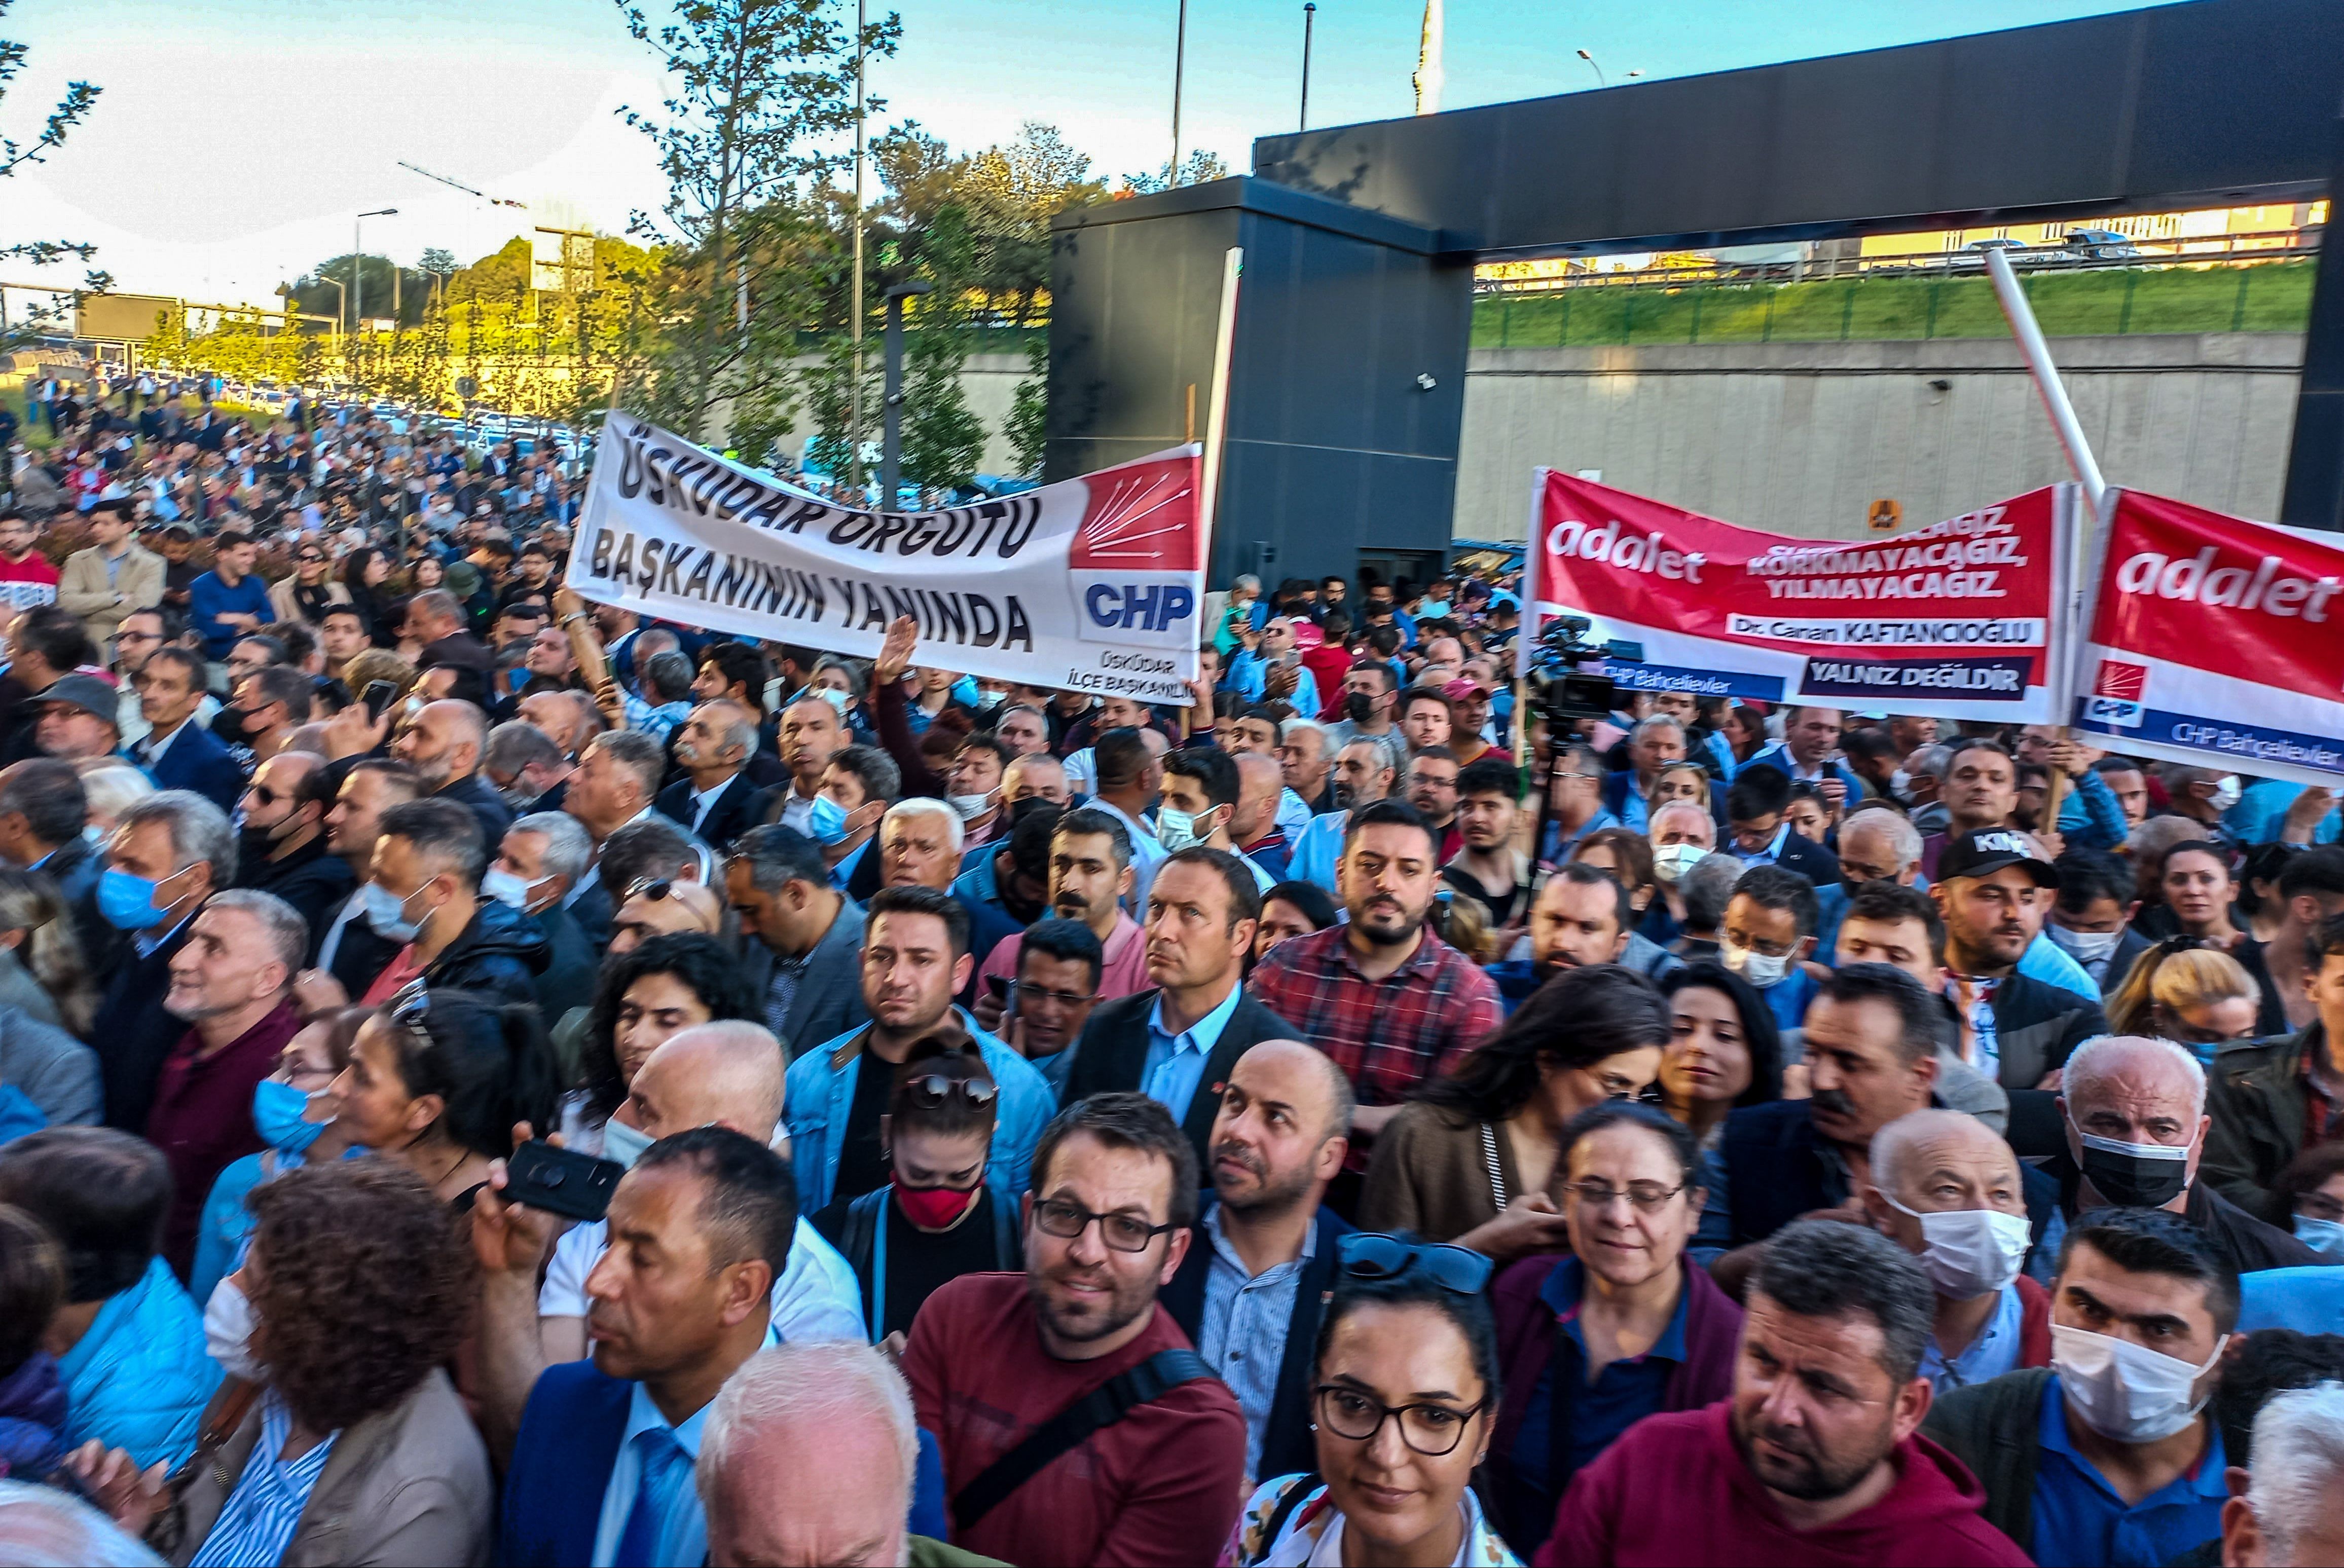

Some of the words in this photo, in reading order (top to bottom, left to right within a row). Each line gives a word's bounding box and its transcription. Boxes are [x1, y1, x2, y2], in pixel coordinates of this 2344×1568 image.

[1546, 519, 1708, 584] adalet
[590, 528, 826, 622] BAŞKANININ
[828, 577, 1033, 652] YANINDA
[2116, 546, 2343, 623] adalet
[1086, 584, 1193, 631] CHP
[1736, 619, 1764, 634] Dr.
[1770, 622, 1837, 641] Canan
[1845, 618, 2031, 643] KAFTANCIOĞLU
[1101, 650, 1176, 675] ÜSKÜDAR
[1810, 662, 1900, 685] YALNIZ
[1901, 663, 2020, 691] DEĞİLDİR
[1067, 668, 1103, 689] İLÇE
[2172, 723, 2219, 744] CHP
